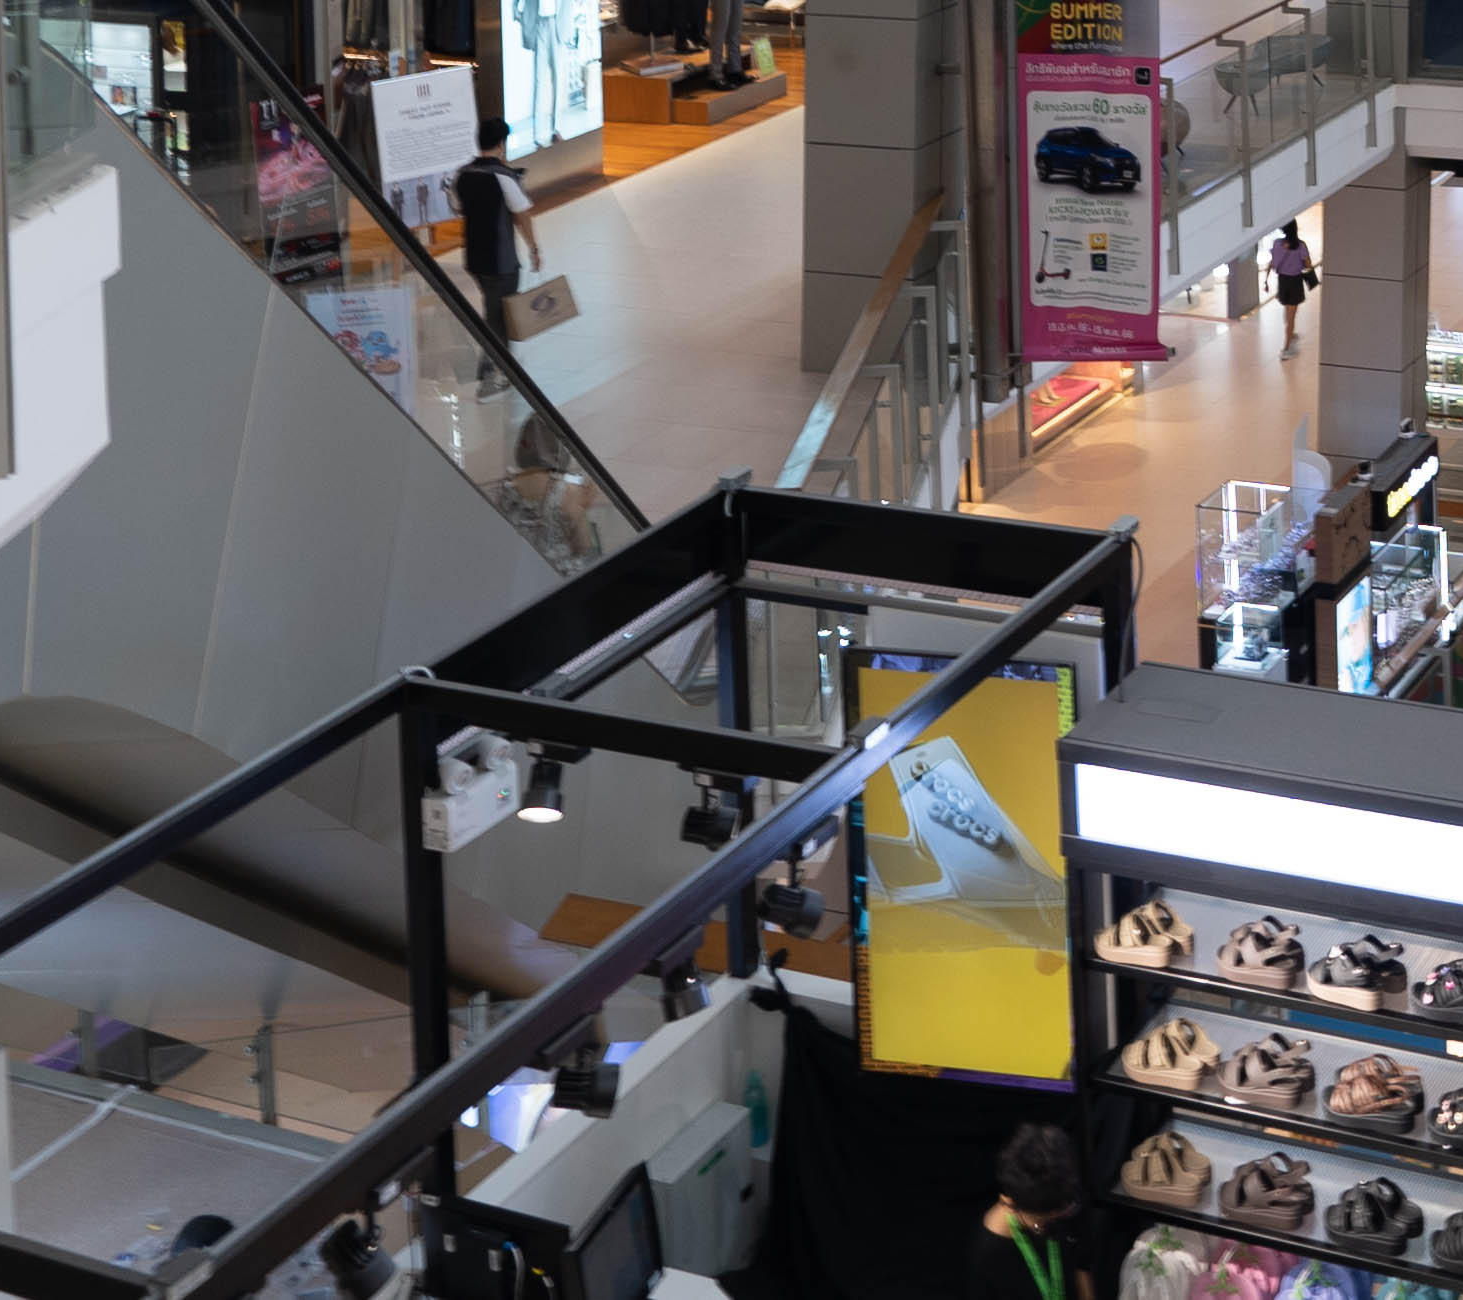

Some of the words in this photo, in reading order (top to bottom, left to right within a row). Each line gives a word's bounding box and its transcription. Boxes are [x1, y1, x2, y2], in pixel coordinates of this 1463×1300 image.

[1049, 1, 1123, 21] SUMMER
[1049, 22, 1123, 42] EDITION
[1092, 98, 1110, 115] 60
[928, 800, 1000, 846] crocs
